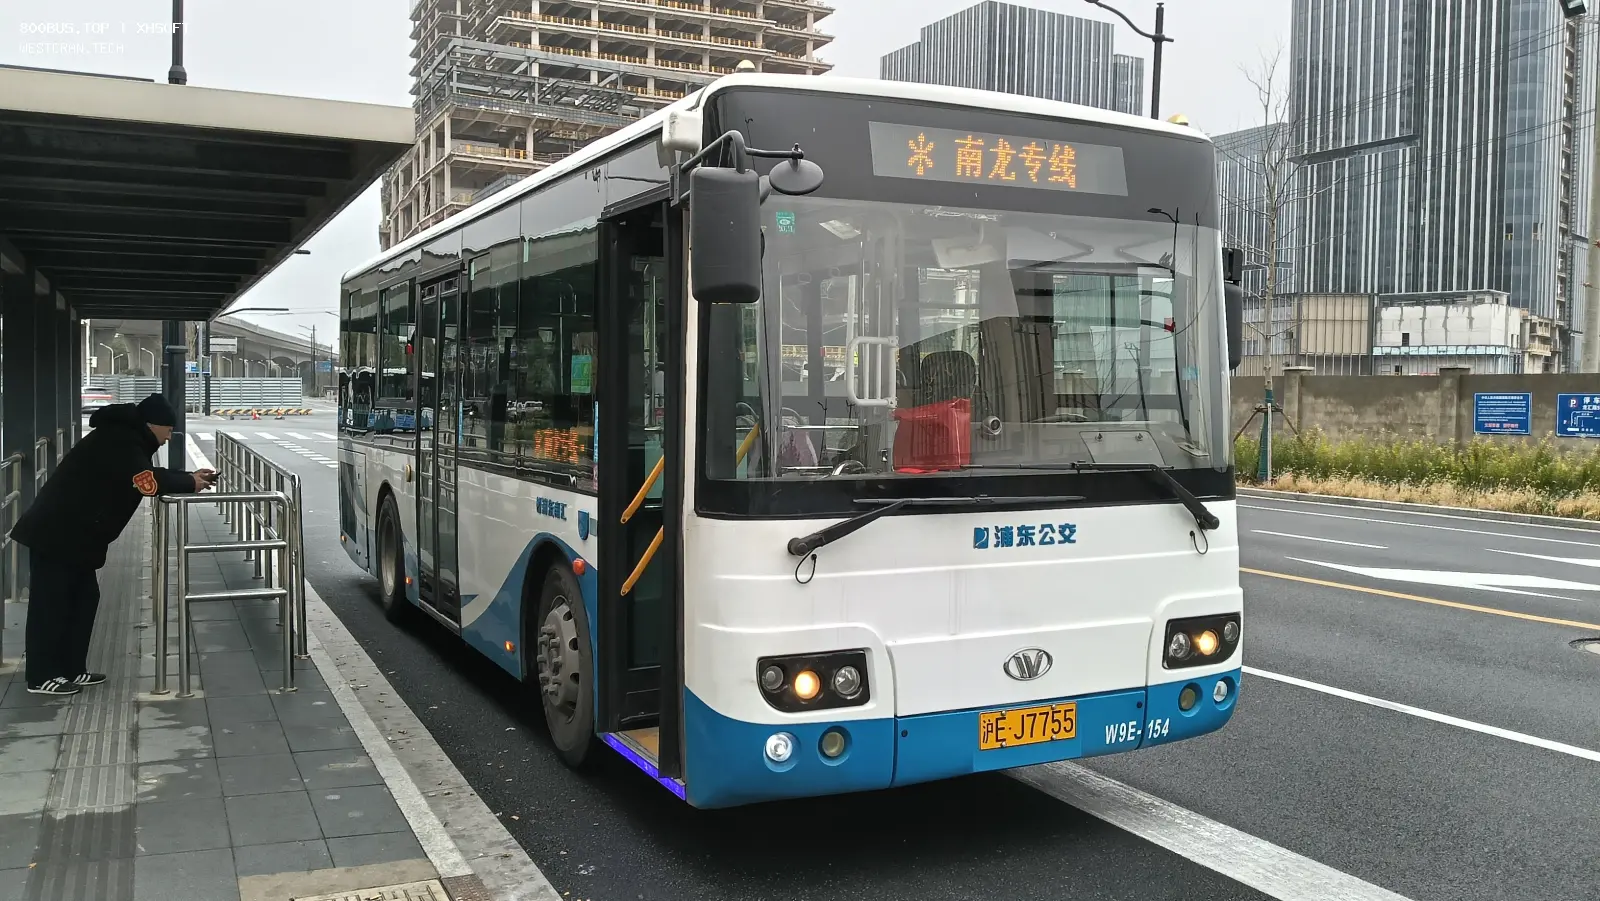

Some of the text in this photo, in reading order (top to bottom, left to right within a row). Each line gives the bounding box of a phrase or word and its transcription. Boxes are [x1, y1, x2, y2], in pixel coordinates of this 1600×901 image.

[954, 135, 1077, 189] 南龙专线
[993, 523, 1077, 548] 浦东公交
